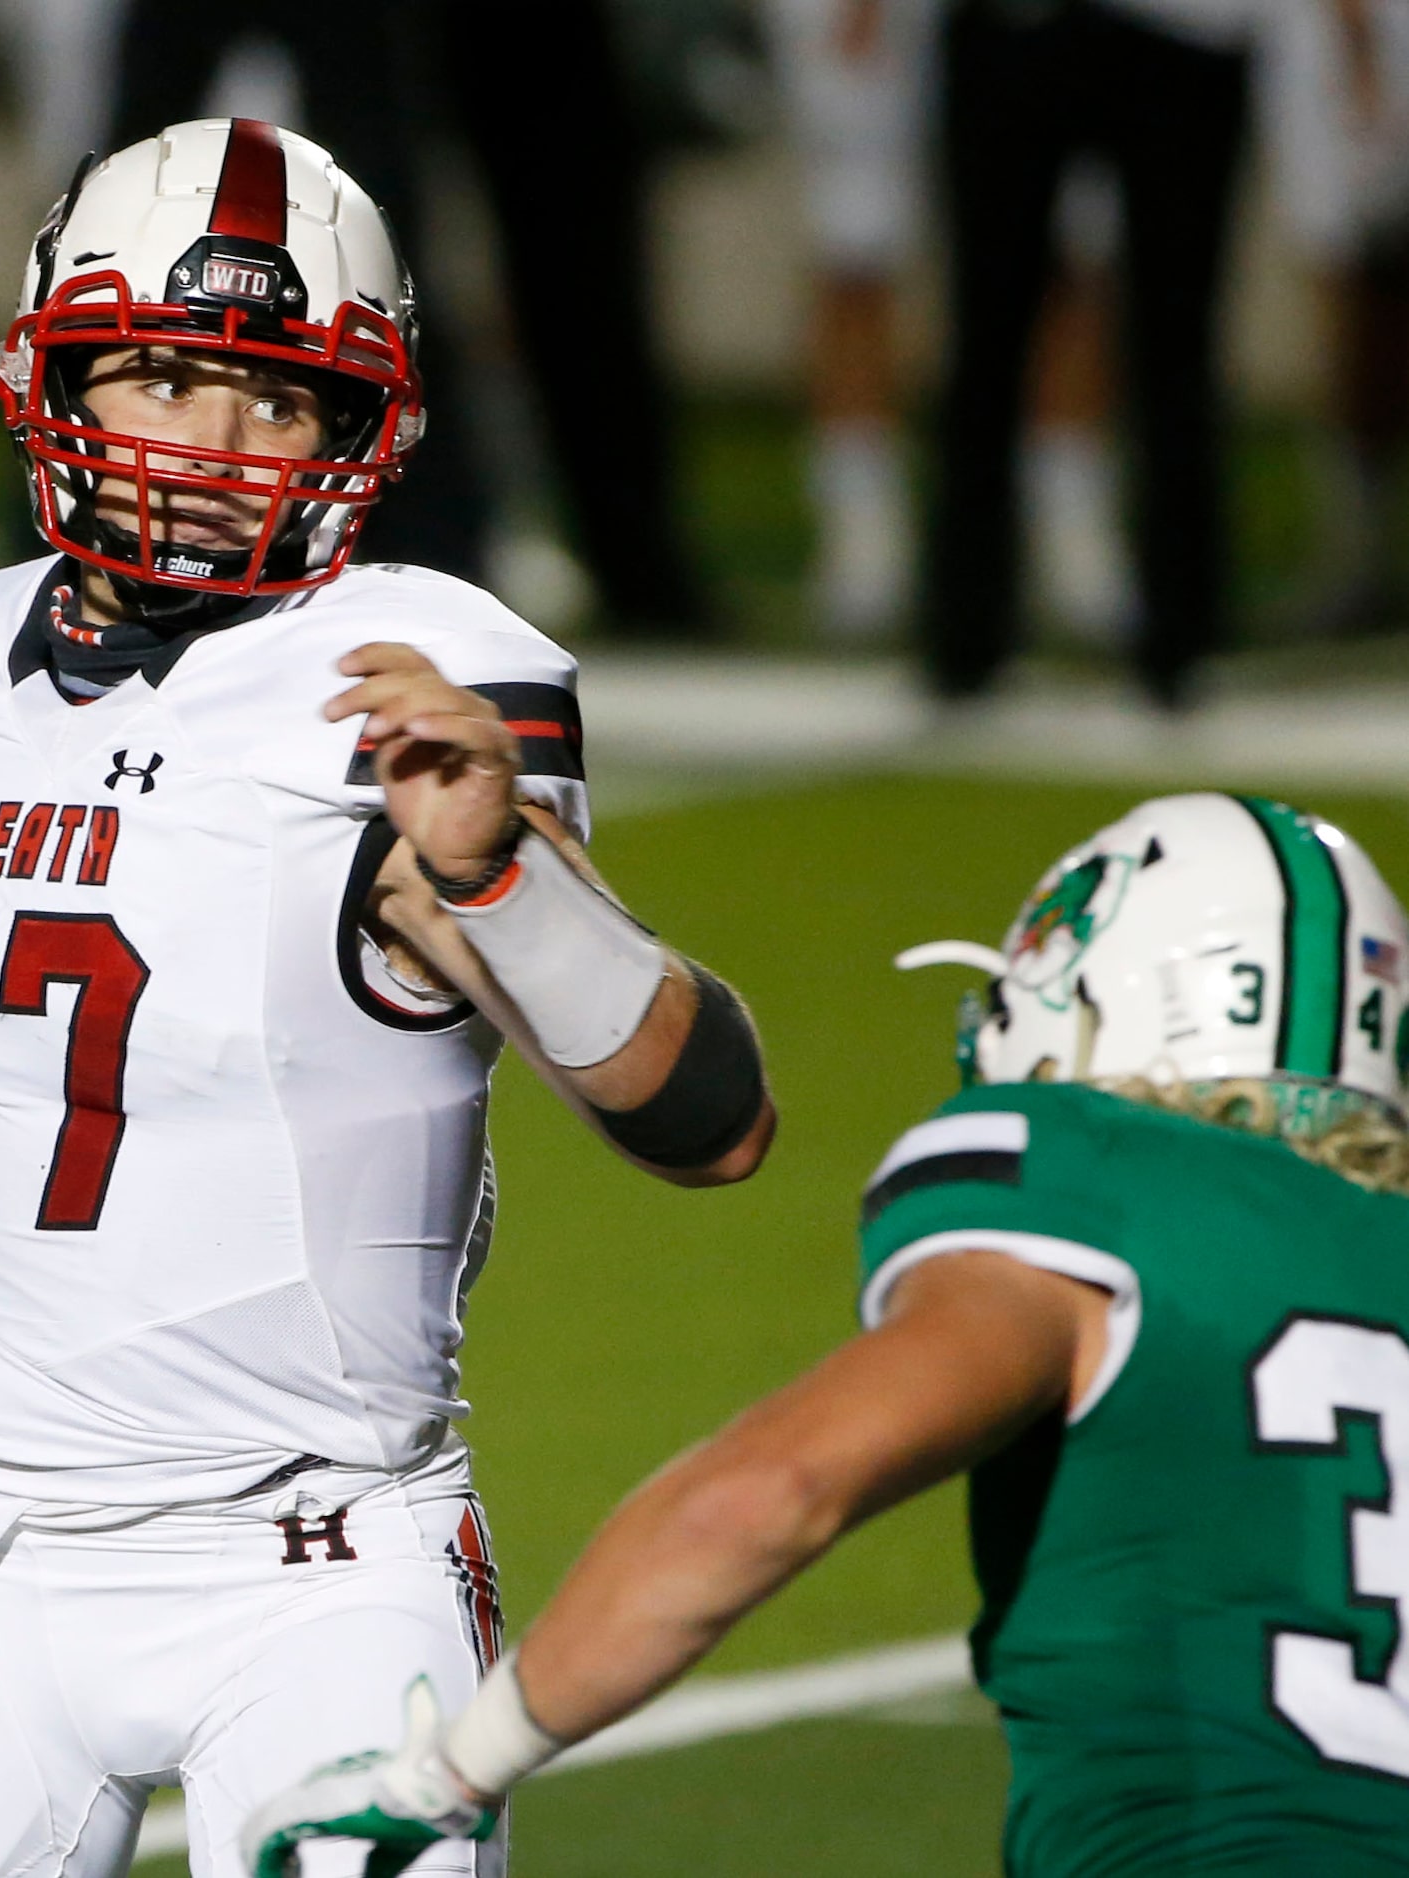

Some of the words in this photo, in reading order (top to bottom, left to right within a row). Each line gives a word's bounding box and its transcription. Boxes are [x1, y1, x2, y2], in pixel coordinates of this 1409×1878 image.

[212, 264, 269, 297] WTD
[1227, 962, 1264, 1025] 3
[1358, 987, 1383, 1053] 4
[275, 1507, 358, 1565] H
